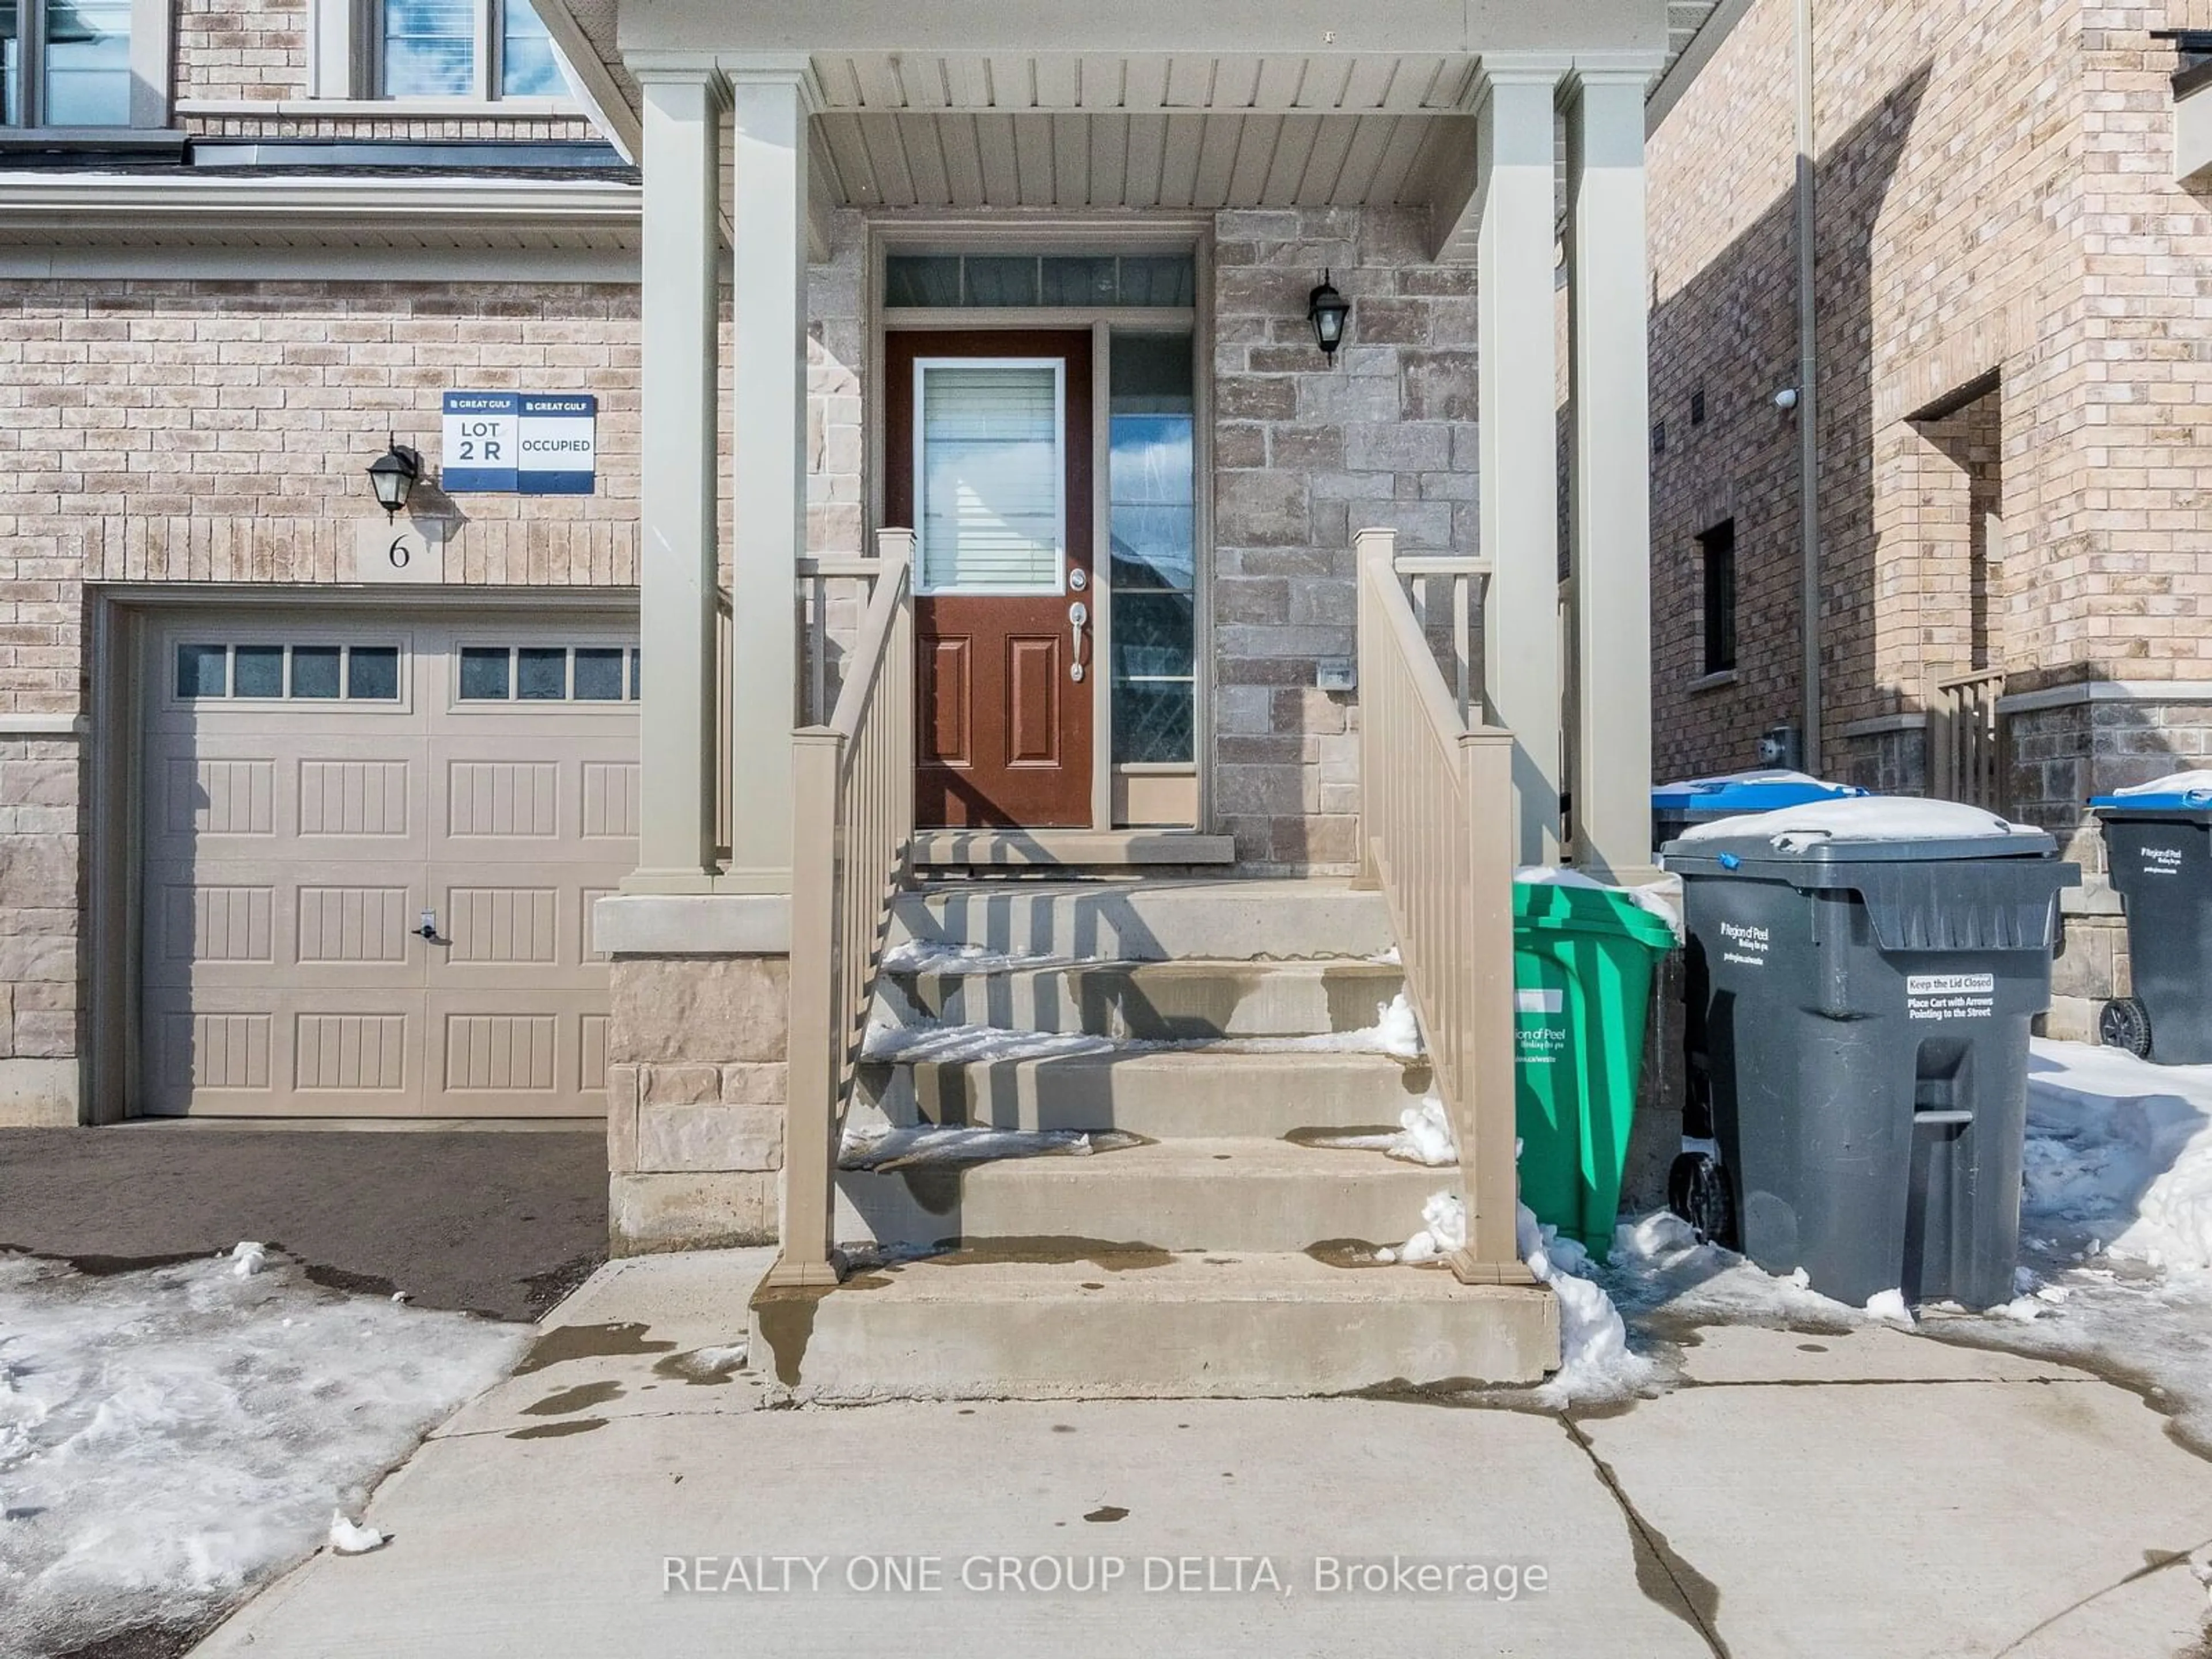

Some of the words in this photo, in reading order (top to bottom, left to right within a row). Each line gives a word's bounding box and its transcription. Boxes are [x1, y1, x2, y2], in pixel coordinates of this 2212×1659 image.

[462, 423, 500, 437] LOT
[460, 441, 474, 460] 2
[485, 441, 501, 460] R
[522, 441, 590, 451] OCCUPIED
[389, 533, 410, 568] 6
[1910, 980, 1931, 990] Keep
[1934, 979, 1948, 988] the
[1950, 978, 1962, 987] Lid
[1964, 977, 1991, 987] Closed
[1908, 998, 1929, 1007] Place
[1930, 998, 1946, 1007] Cart
[1948, 997, 1965, 1006] with
[1966, 997, 1993, 1006] Arrows
[1910, 1009, 1942, 1021] Pointing
[1944, 1009, 1952, 1017] to
[1953, 1008, 1966, 1017] the
[1967, 1008, 1991, 1017] Street
[1544, 1028, 1566, 1040] Peel
